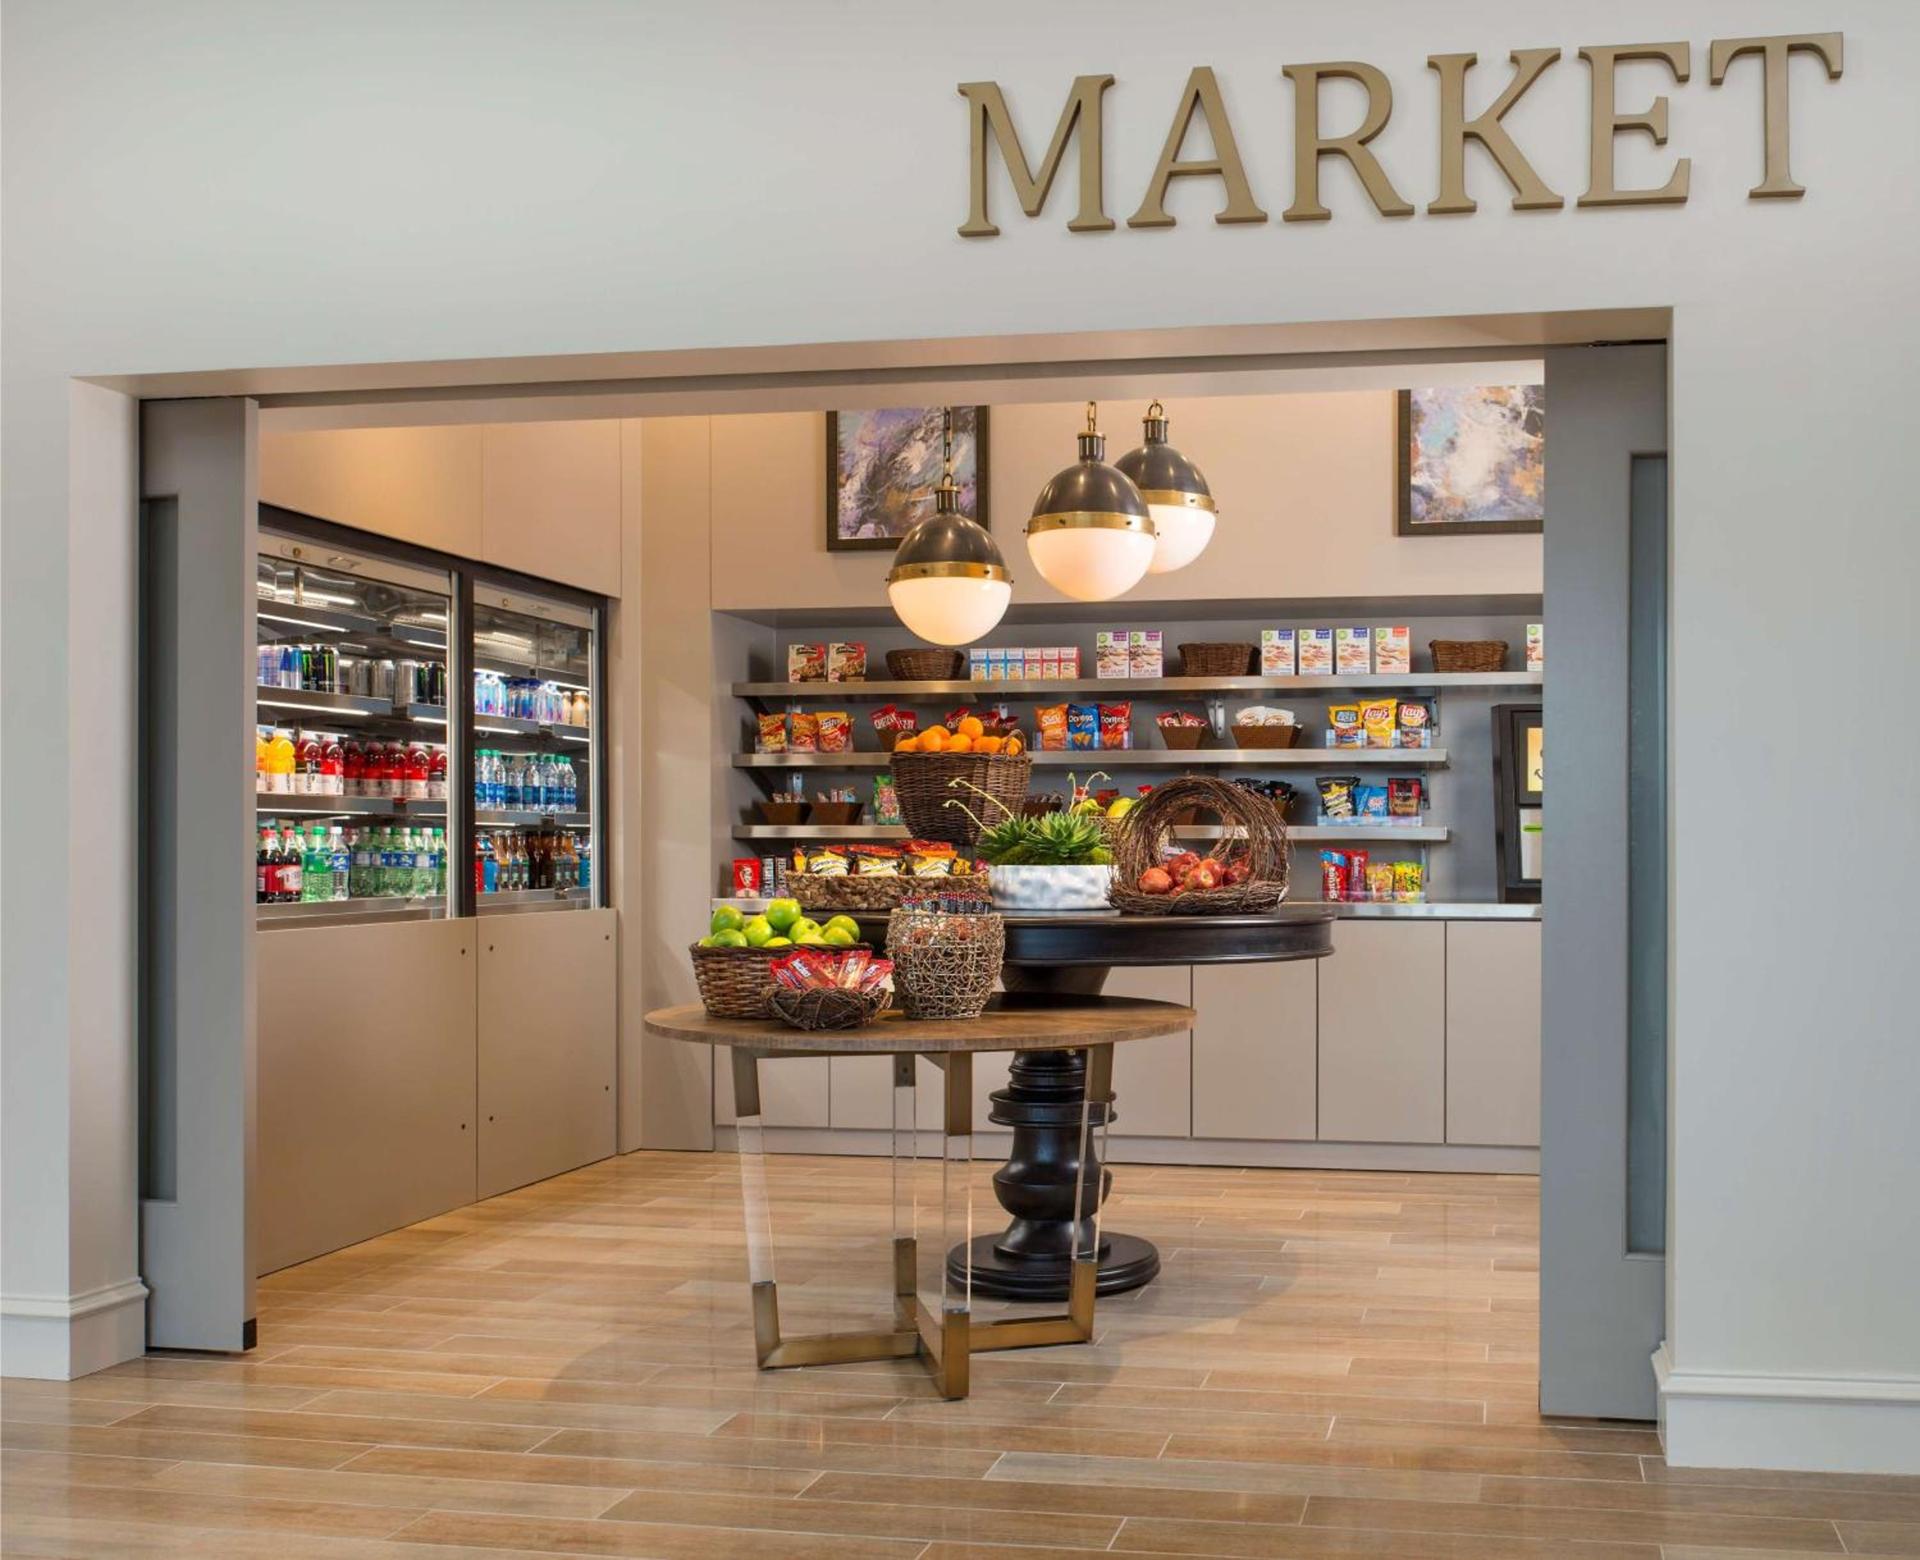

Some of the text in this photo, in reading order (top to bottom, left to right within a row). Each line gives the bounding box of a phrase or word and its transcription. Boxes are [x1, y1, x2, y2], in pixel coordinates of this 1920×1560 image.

[957, 31, 1844, 238] MARKET
[1069, 714, 1094, 727] Doritos
[1101, 715, 1126, 727] Doritos
